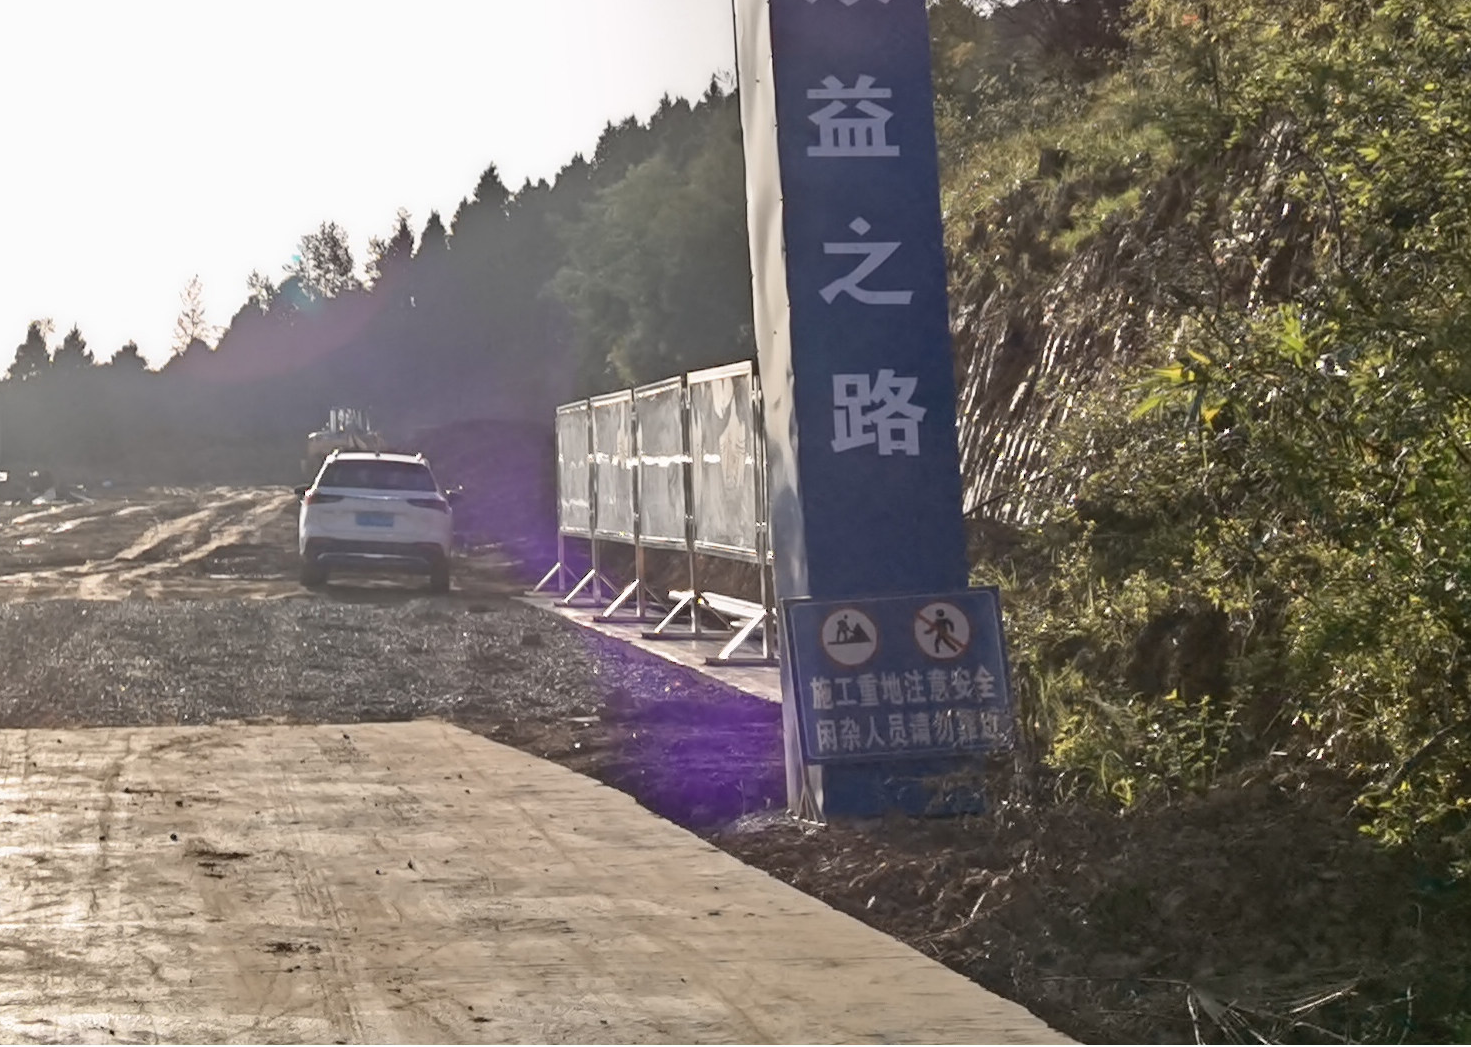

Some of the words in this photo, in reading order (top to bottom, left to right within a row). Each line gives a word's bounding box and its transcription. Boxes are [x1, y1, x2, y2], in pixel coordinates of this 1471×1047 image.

[809, 664, 997, 710] 施工重地注意安全
